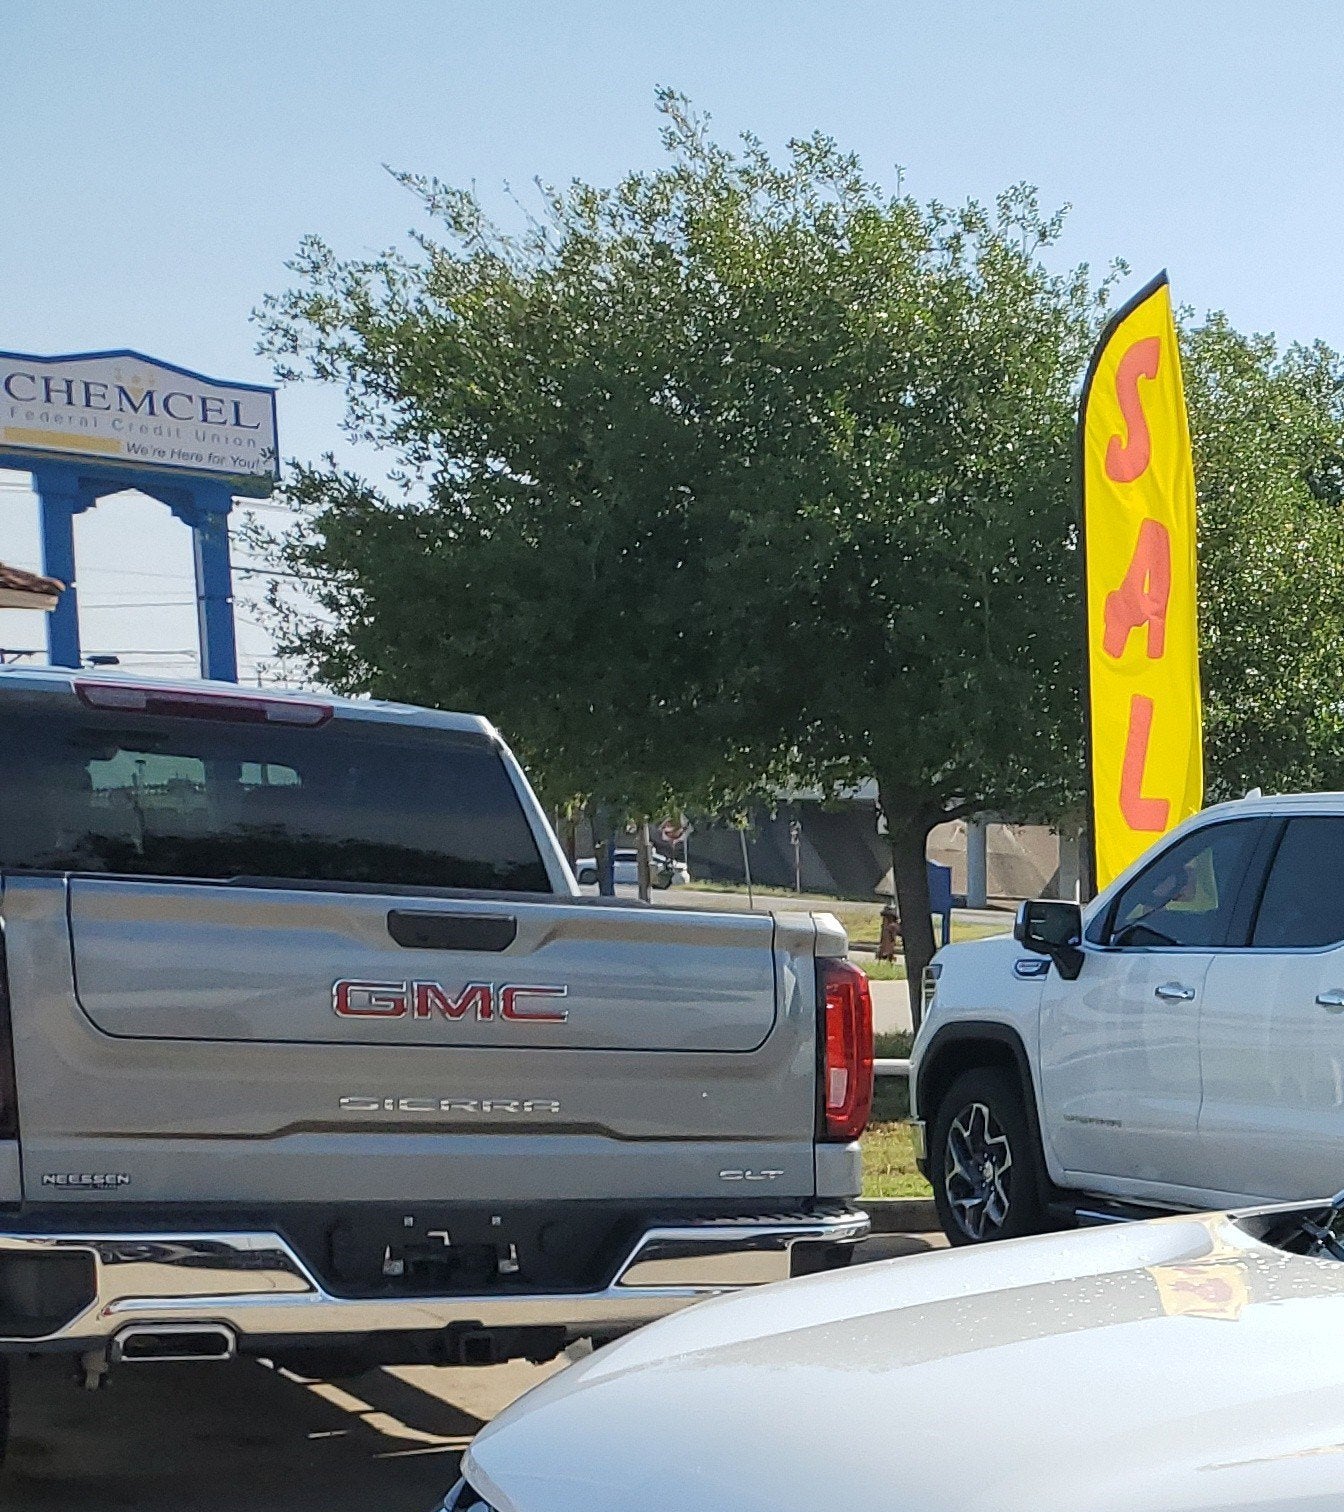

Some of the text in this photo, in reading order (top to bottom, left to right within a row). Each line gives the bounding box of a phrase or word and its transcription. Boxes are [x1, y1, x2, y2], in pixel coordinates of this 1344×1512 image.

[4, 371, 261, 430] CHEMCEL
[10, 406, 257, 448] Federal Credit Union
[126, 441, 261, 470] We're Here for You!
[332, 978, 569, 1023] GMC
[339, 1096, 561, 1113] SIERRA
